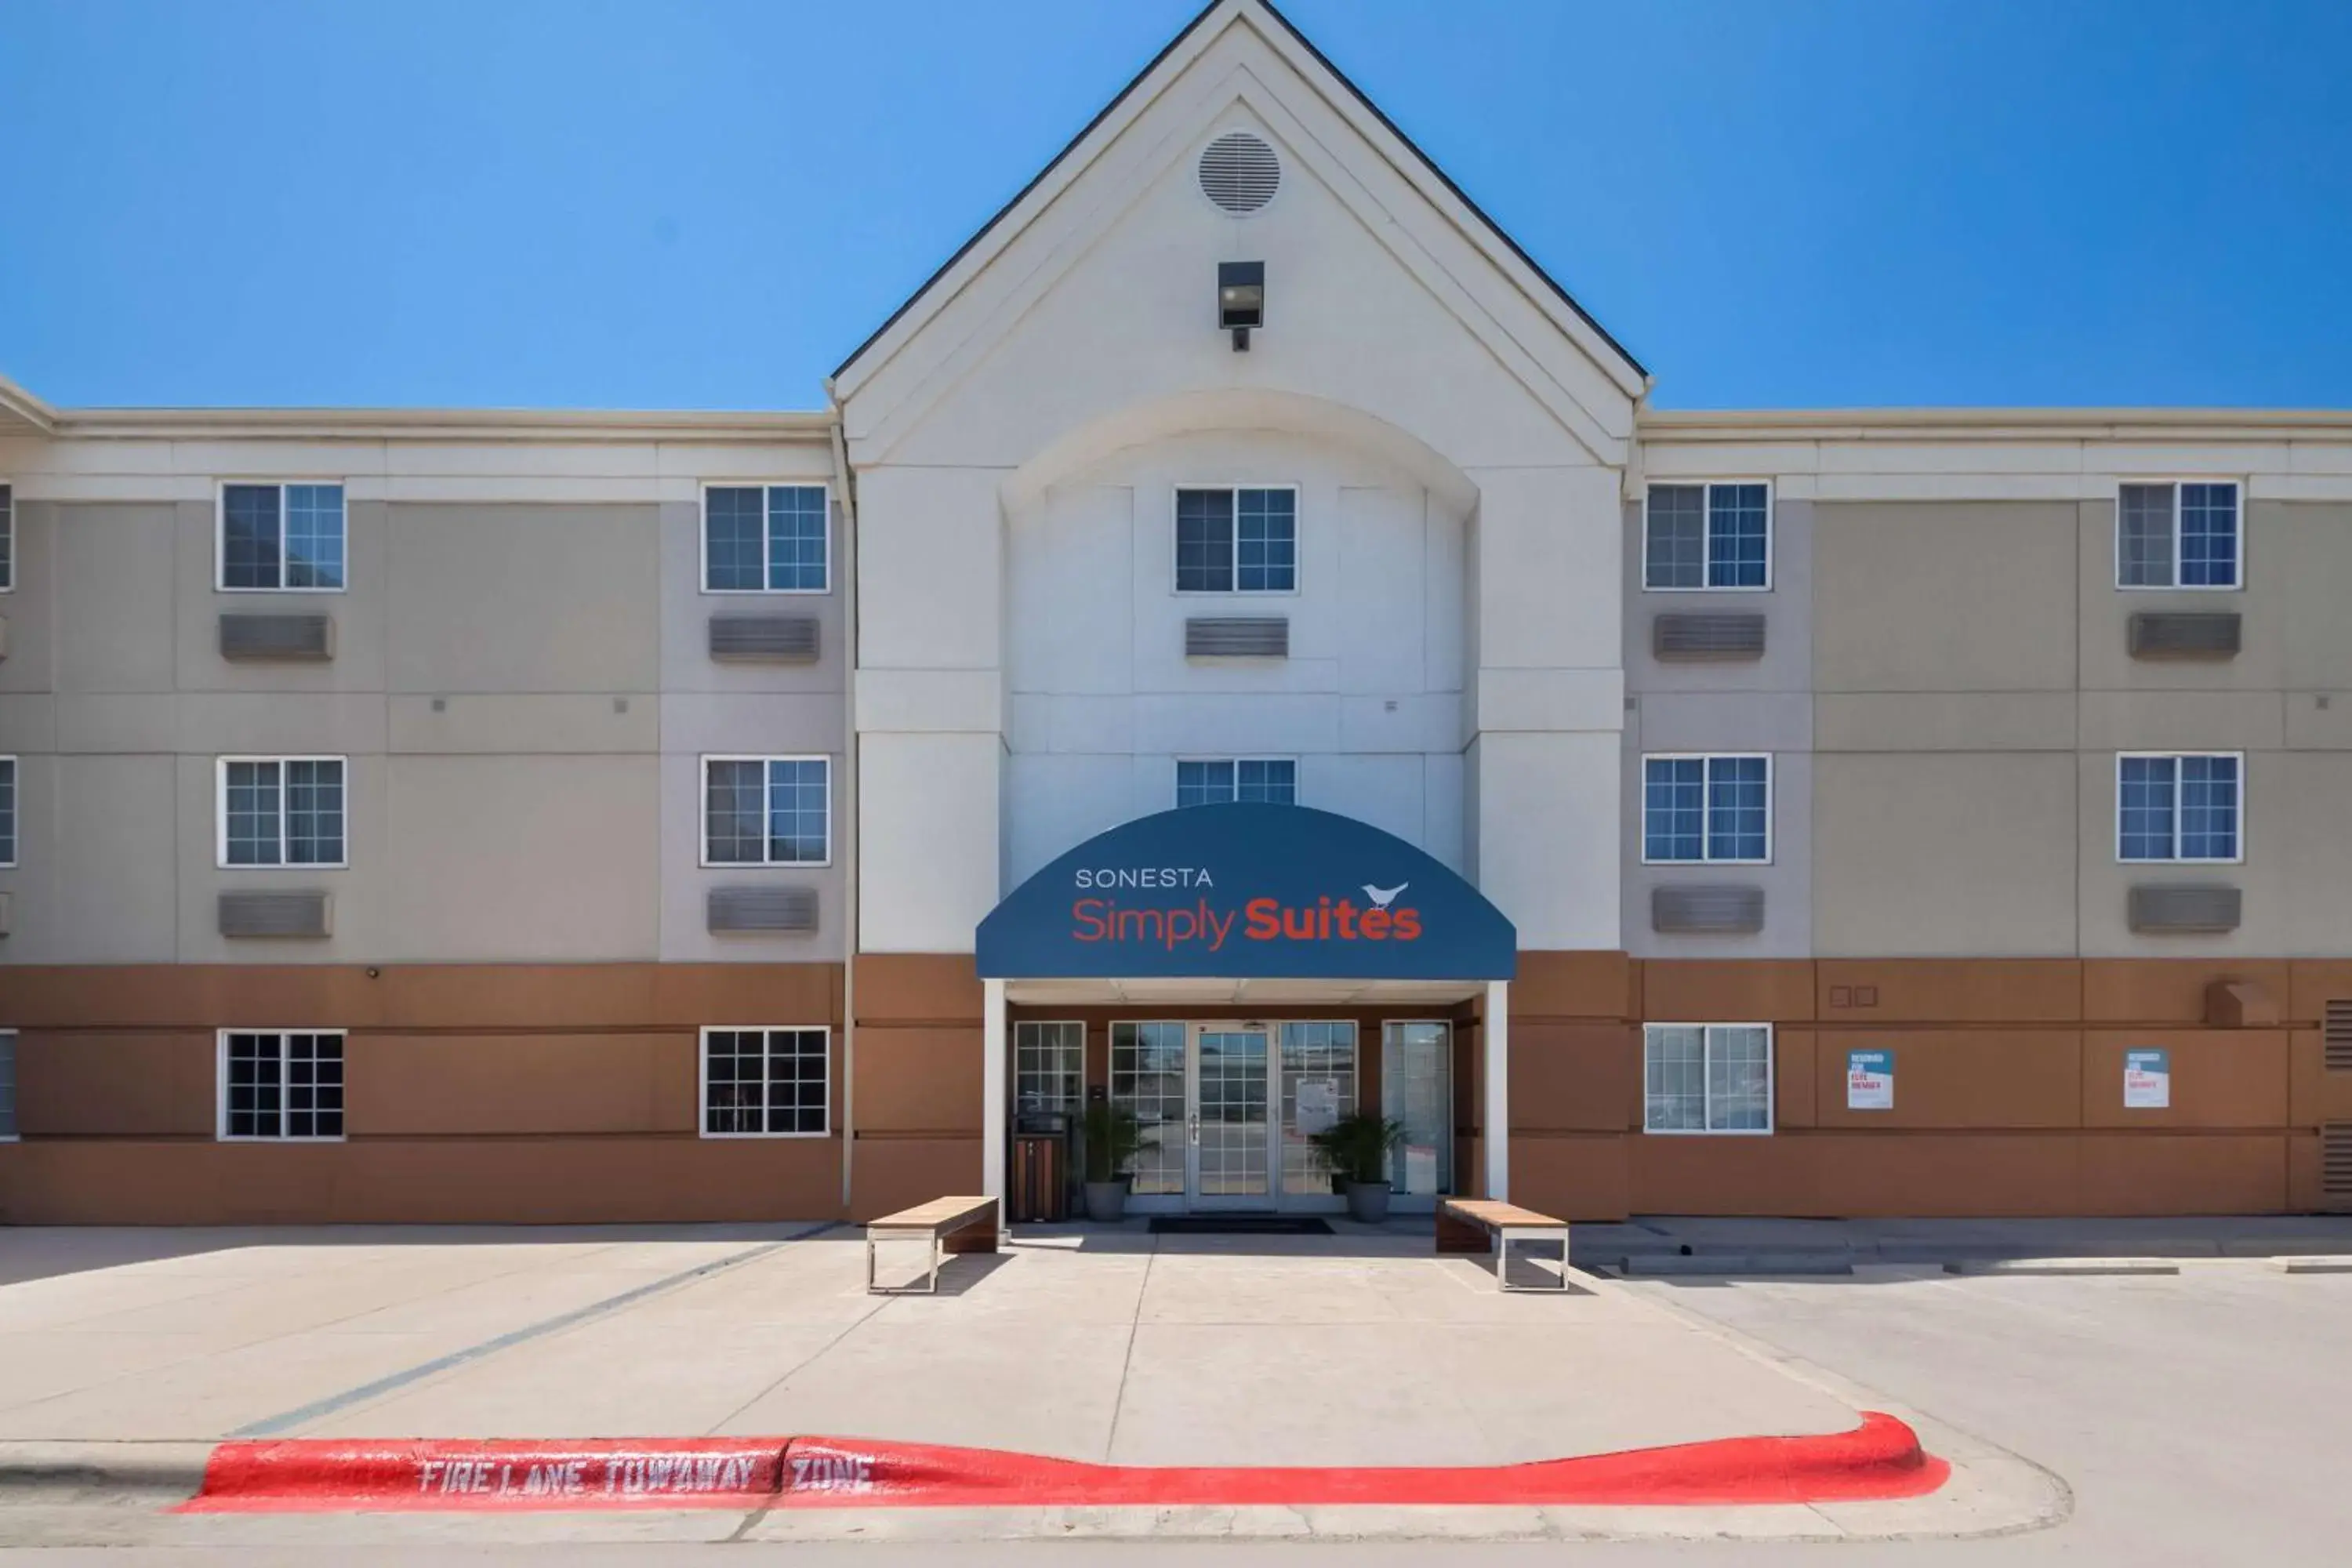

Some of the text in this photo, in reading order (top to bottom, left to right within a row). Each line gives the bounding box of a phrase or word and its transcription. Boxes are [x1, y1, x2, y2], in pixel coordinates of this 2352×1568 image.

[1076, 868, 1214, 887] SONESTA
[1072, 895, 1422, 952] Simply Suites
[419, 1461, 495, 1493] FIRE
[499, 1460, 587, 1495] LANE
[791, 1456, 875, 1492] ZONE
